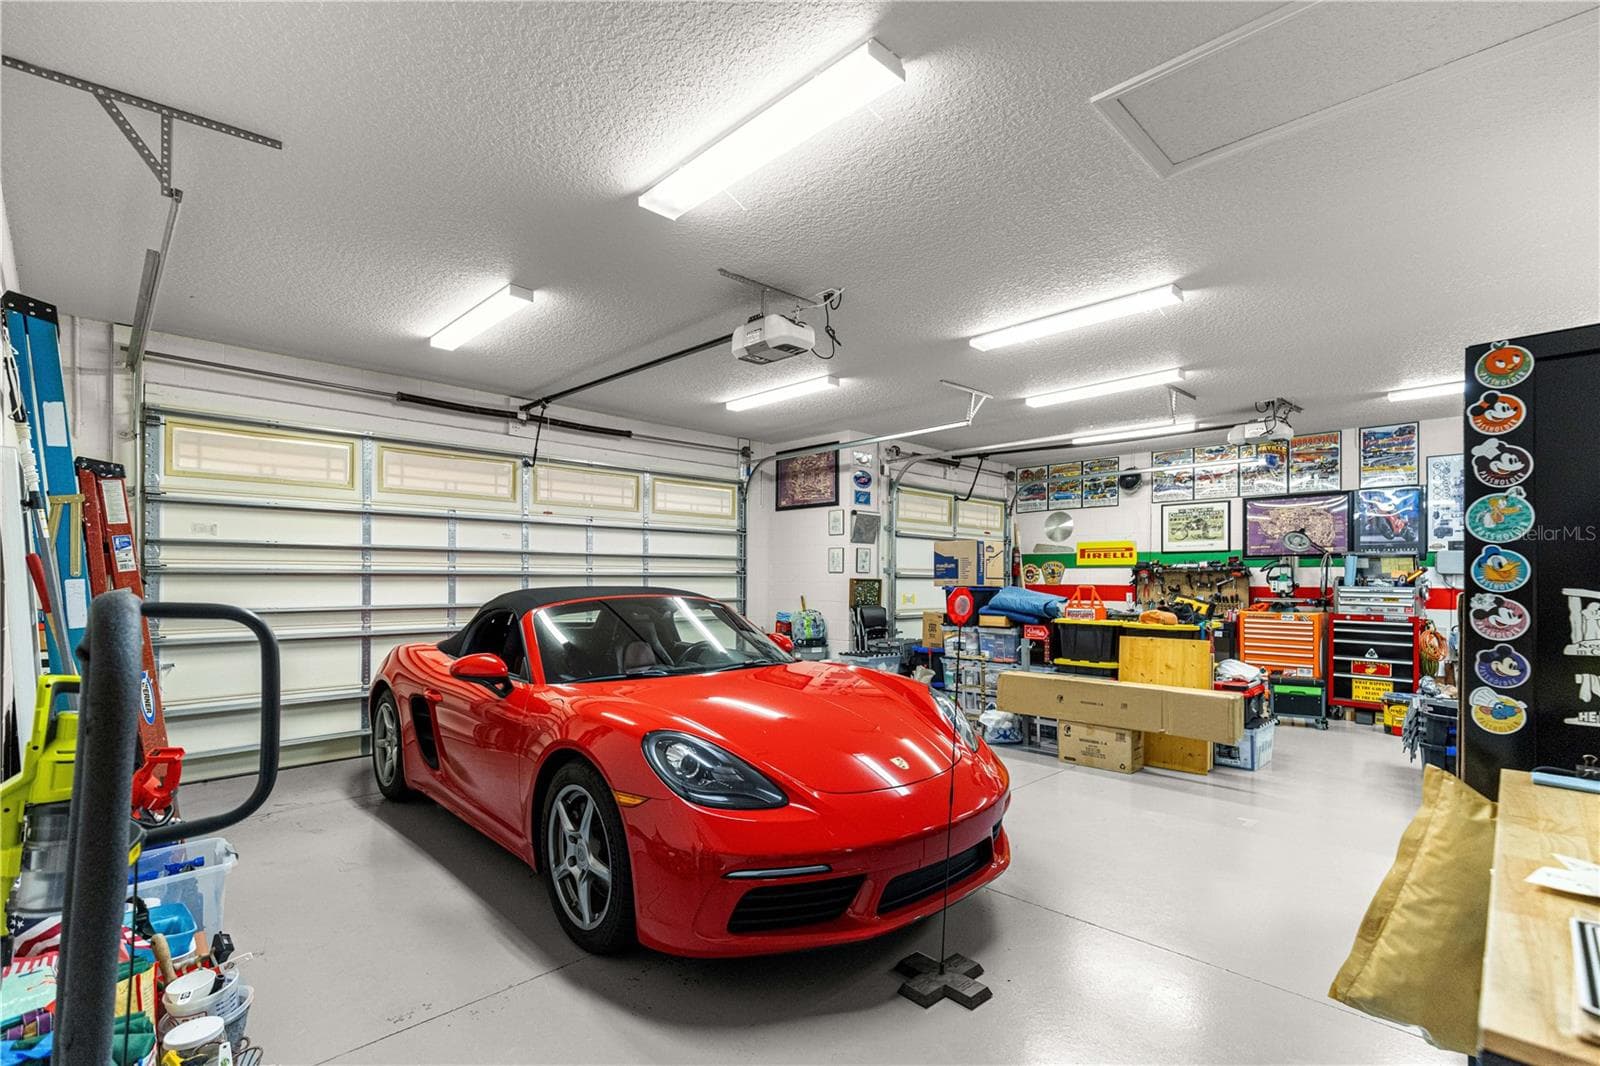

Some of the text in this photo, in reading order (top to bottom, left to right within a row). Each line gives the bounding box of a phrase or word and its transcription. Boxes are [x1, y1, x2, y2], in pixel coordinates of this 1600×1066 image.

[1479, 371, 1526, 386] PASSHOLDER
[1474, 419, 1518, 432] PASSHOLDER
[1479, 470, 1525, 485] PASSHOLDER
[1080, 547, 1134, 560] PIRELLI
[1476, 575, 1524, 590] PASSHOLDER
[1475, 621, 1521, 638] PASSHOLDER
